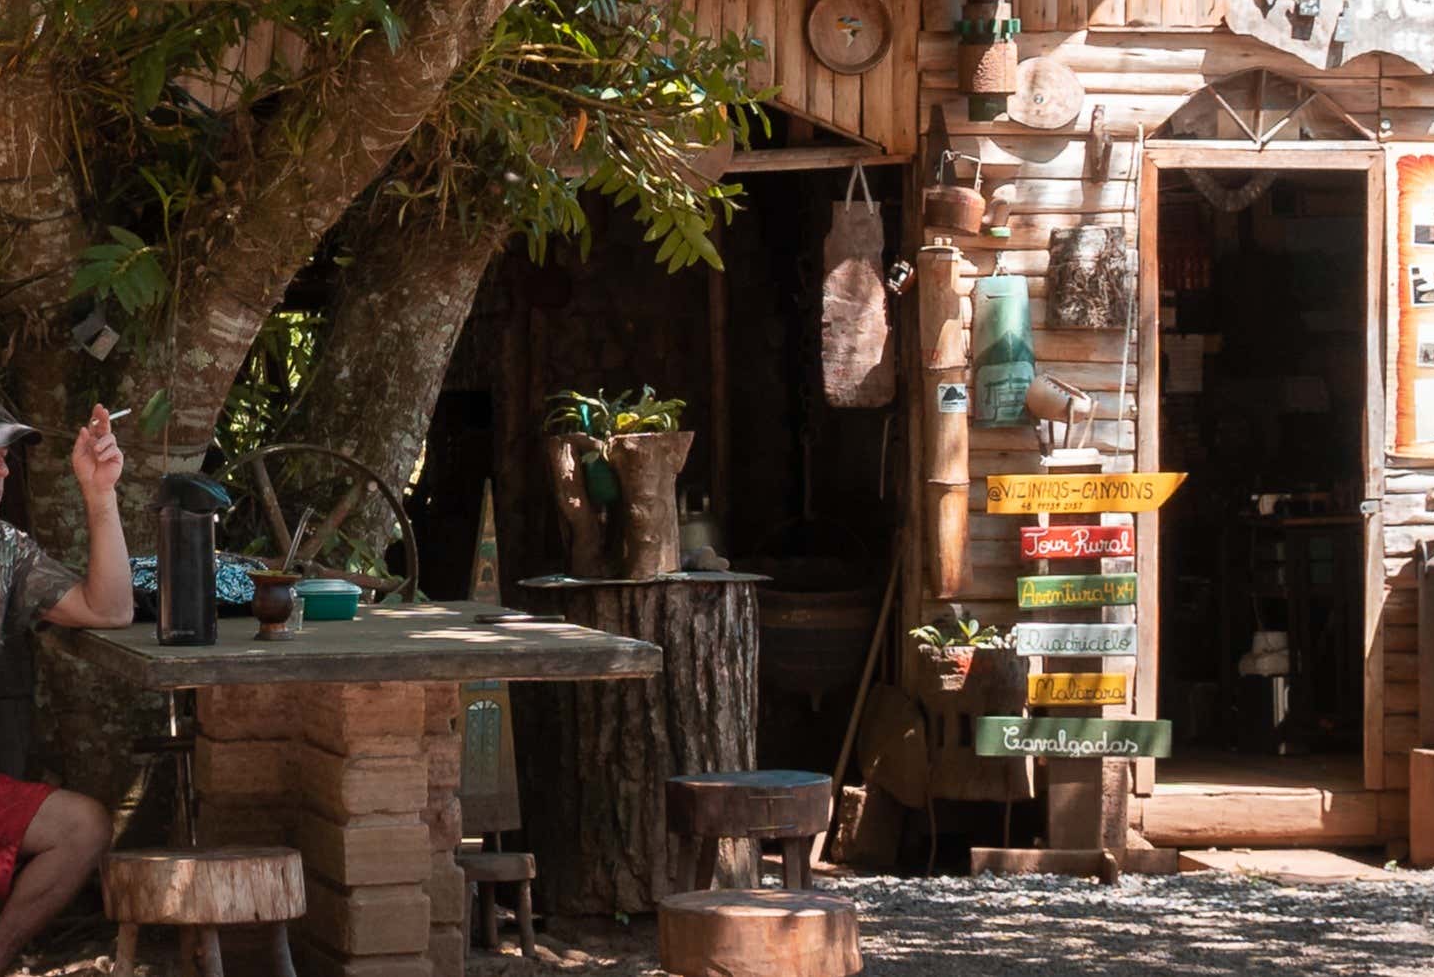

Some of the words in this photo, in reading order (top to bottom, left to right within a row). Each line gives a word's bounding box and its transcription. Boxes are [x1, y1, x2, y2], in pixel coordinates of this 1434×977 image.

[1023, 529, 1072, 556] Tour
[1071, 528, 1133, 557] Rural
[1018, 580, 1105, 608] Aventura
[1103, 581, 1134, 601] 4x4
[1019, 628, 1132, 652] Quadriciclo
[1002, 725, 1139, 757] Cavalgadas
